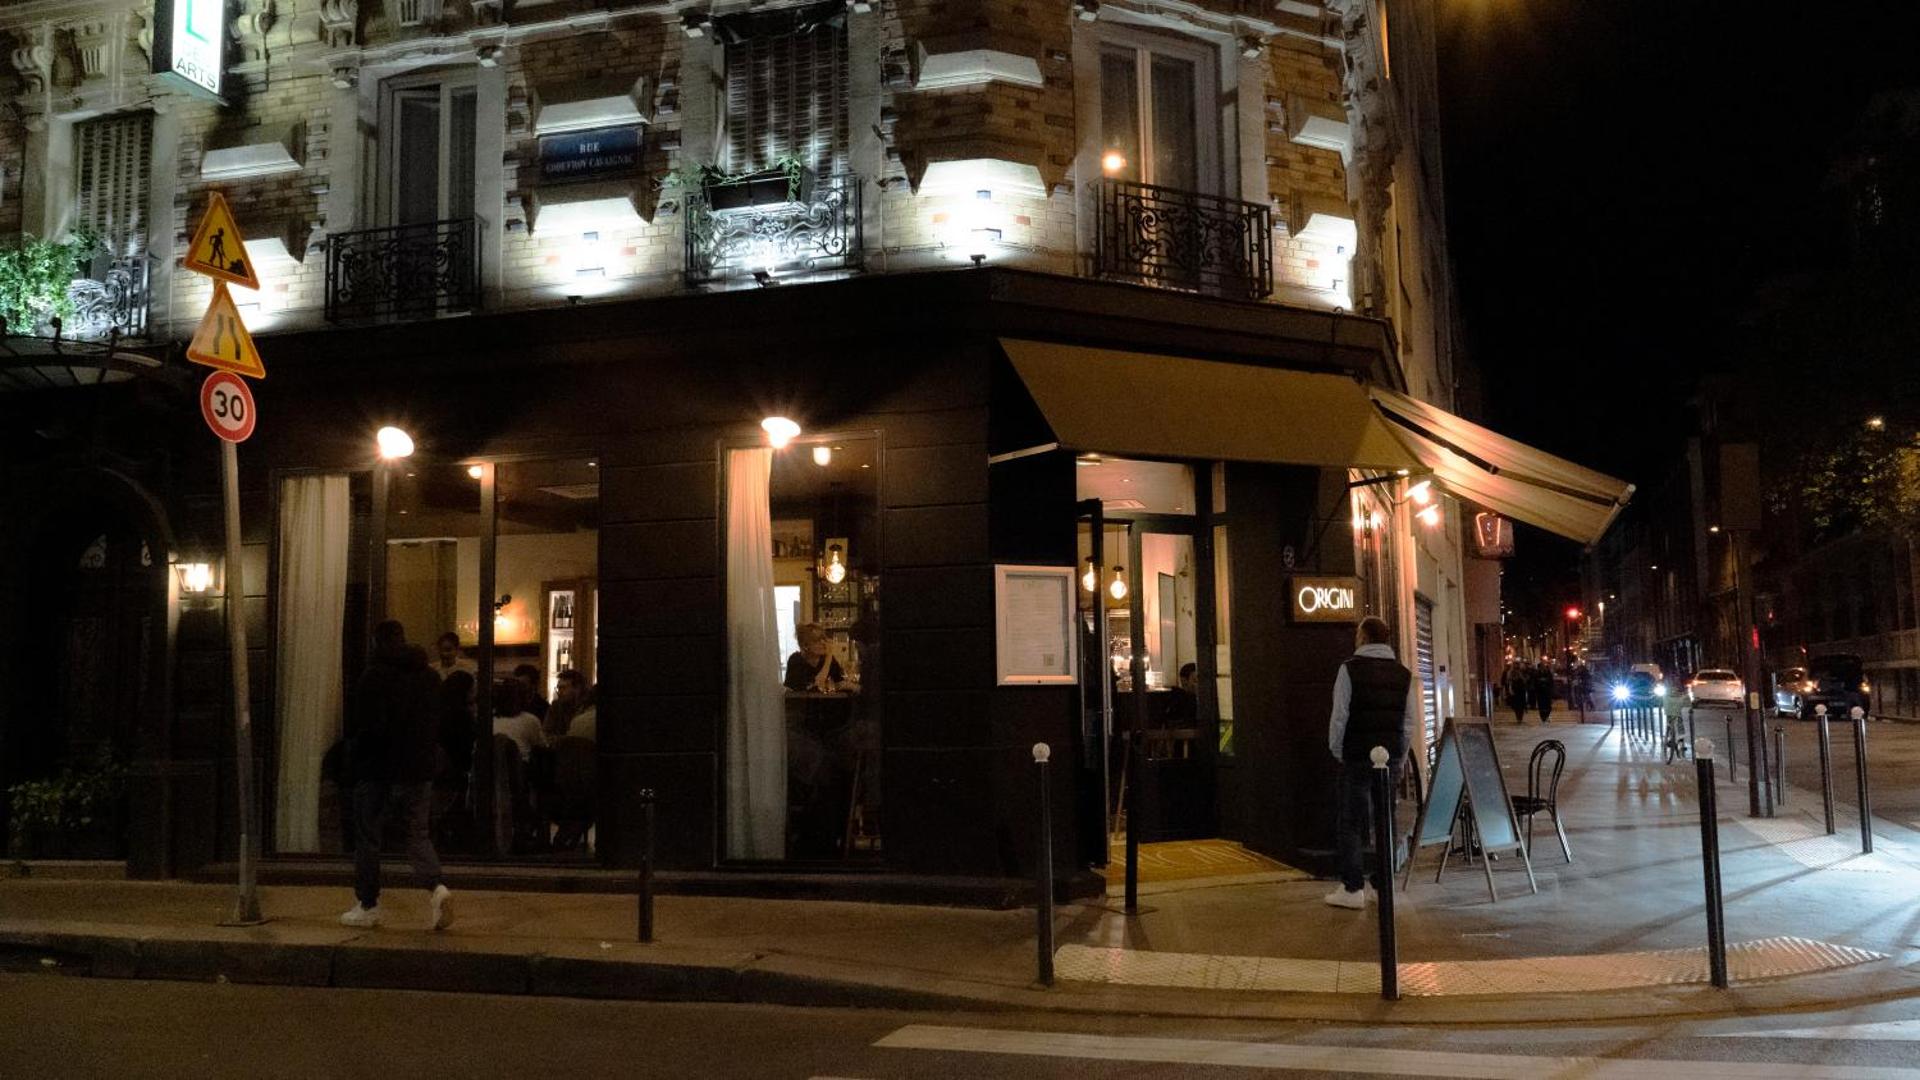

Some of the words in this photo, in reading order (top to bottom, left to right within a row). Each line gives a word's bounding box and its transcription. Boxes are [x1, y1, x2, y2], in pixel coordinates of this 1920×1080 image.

[176, 57, 216, 89] ARTS
[579, 142, 600, 154] RUE
[214, 390, 244, 422] 30
